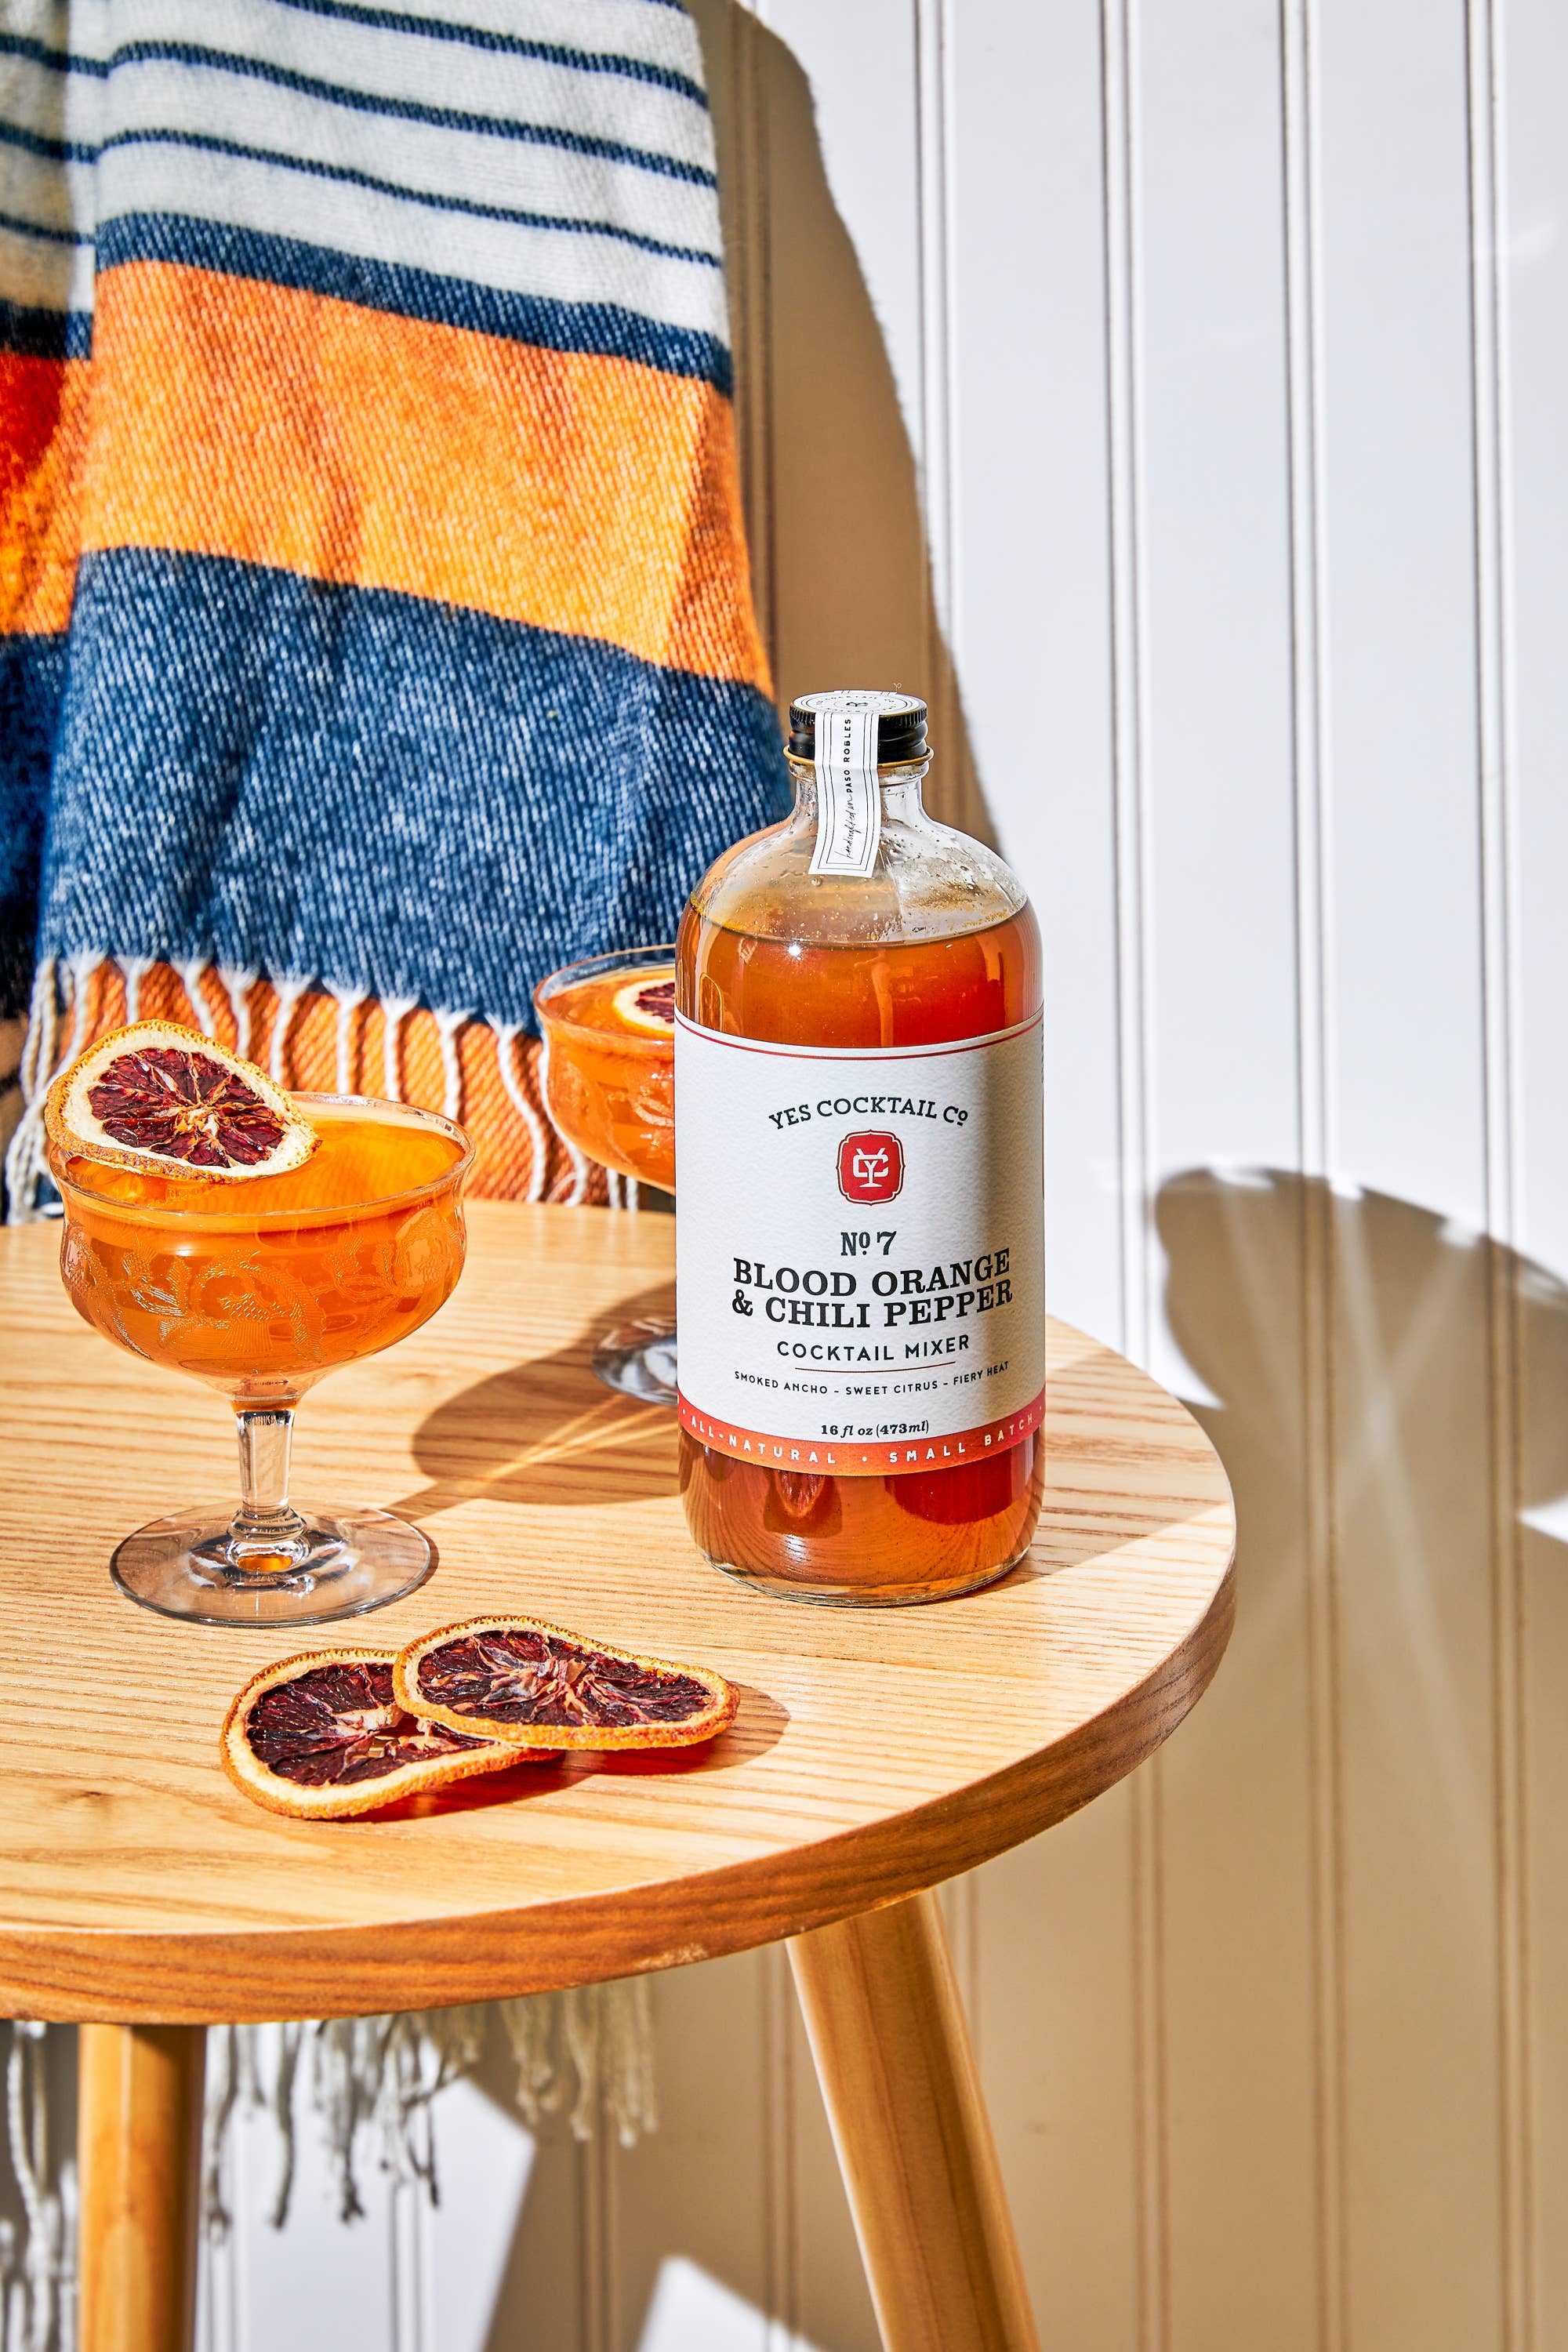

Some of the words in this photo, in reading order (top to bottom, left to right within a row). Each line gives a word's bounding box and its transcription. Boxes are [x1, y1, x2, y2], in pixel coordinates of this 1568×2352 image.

[843, 719, 851, 763] ROBLES
[844, 769, 853, 793] PASO
[847, 794, 854, 810] in
[768, 1104, 811, 1130] YES
[816, 1096, 938, 1120] COCKTAIL
[877, 1230, 897, 1256] 7
[733, 1257, 857, 1297] BLOOD
[871, 1247, 1011, 1297] ORANGE
[731, 1289, 753, 1317] &
[765, 1296, 870, 1328] CHILI
[884, 1279, 1013, 1327] PEPPER
[777, 1341, 895, 1362] COCKTAIL
[905, 1334, 970, 1359] MIXER
[735, 1370, 779, 1389] SMOKED
[783, 1382, 828, 1395] ANCHO
[845, 1386, 888, 1396] SWEET
[893, 1380, 938, 1394] CITRUS
[953, 1370, 983, 1386] FIERY
[986, 1360, 1009, 1377] HEAT
[691, 1415, 836, 1464] ALL-NATURAL
[889, 1442, 966, 1463] SMALL
[984, 1414, 1033, 1446] BATCH
[821, 1425, 838, 1436] 16
[840, 1425, 854, 1439] fl
[858, 1427, 873, 1436] oz
[876, 1420, 929, 1438] (473ml)
